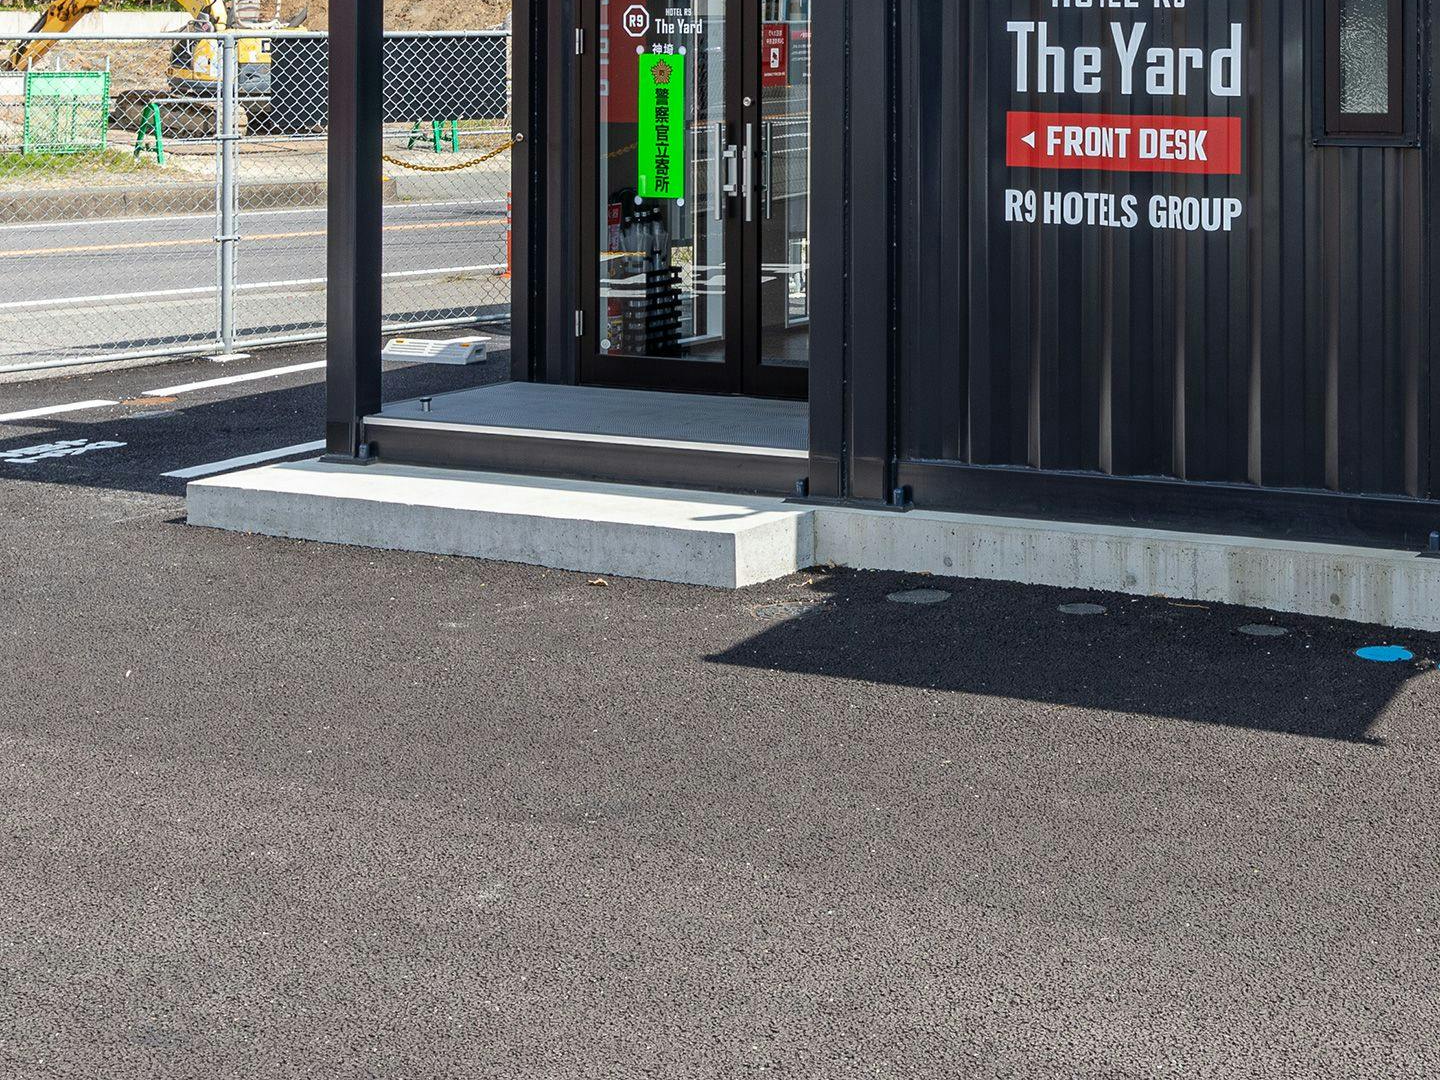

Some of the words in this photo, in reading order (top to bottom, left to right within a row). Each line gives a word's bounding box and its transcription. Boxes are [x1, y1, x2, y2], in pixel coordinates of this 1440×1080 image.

[629, 14, 644, 28] R9
[654, 18, 675, 34] The
[677, 18, 703, 34] Yard
[665, 7, 683, 17] HOTEL
[683, 7, 692, 17] R9
[1006, 21, 1101, 93] The
[1110, 21, 1242, 97] Yard
[655, 87, 670, 194] 警察官立寄所
[1046, 125, 1132, 159] FRONT
[1139, 128, 1208, 162] DESK
[1004, 188, 1037, 224] R9
[1043, 191, 1139, 228] HOTELS
[1148, 194, 1243, 232] GROUP
